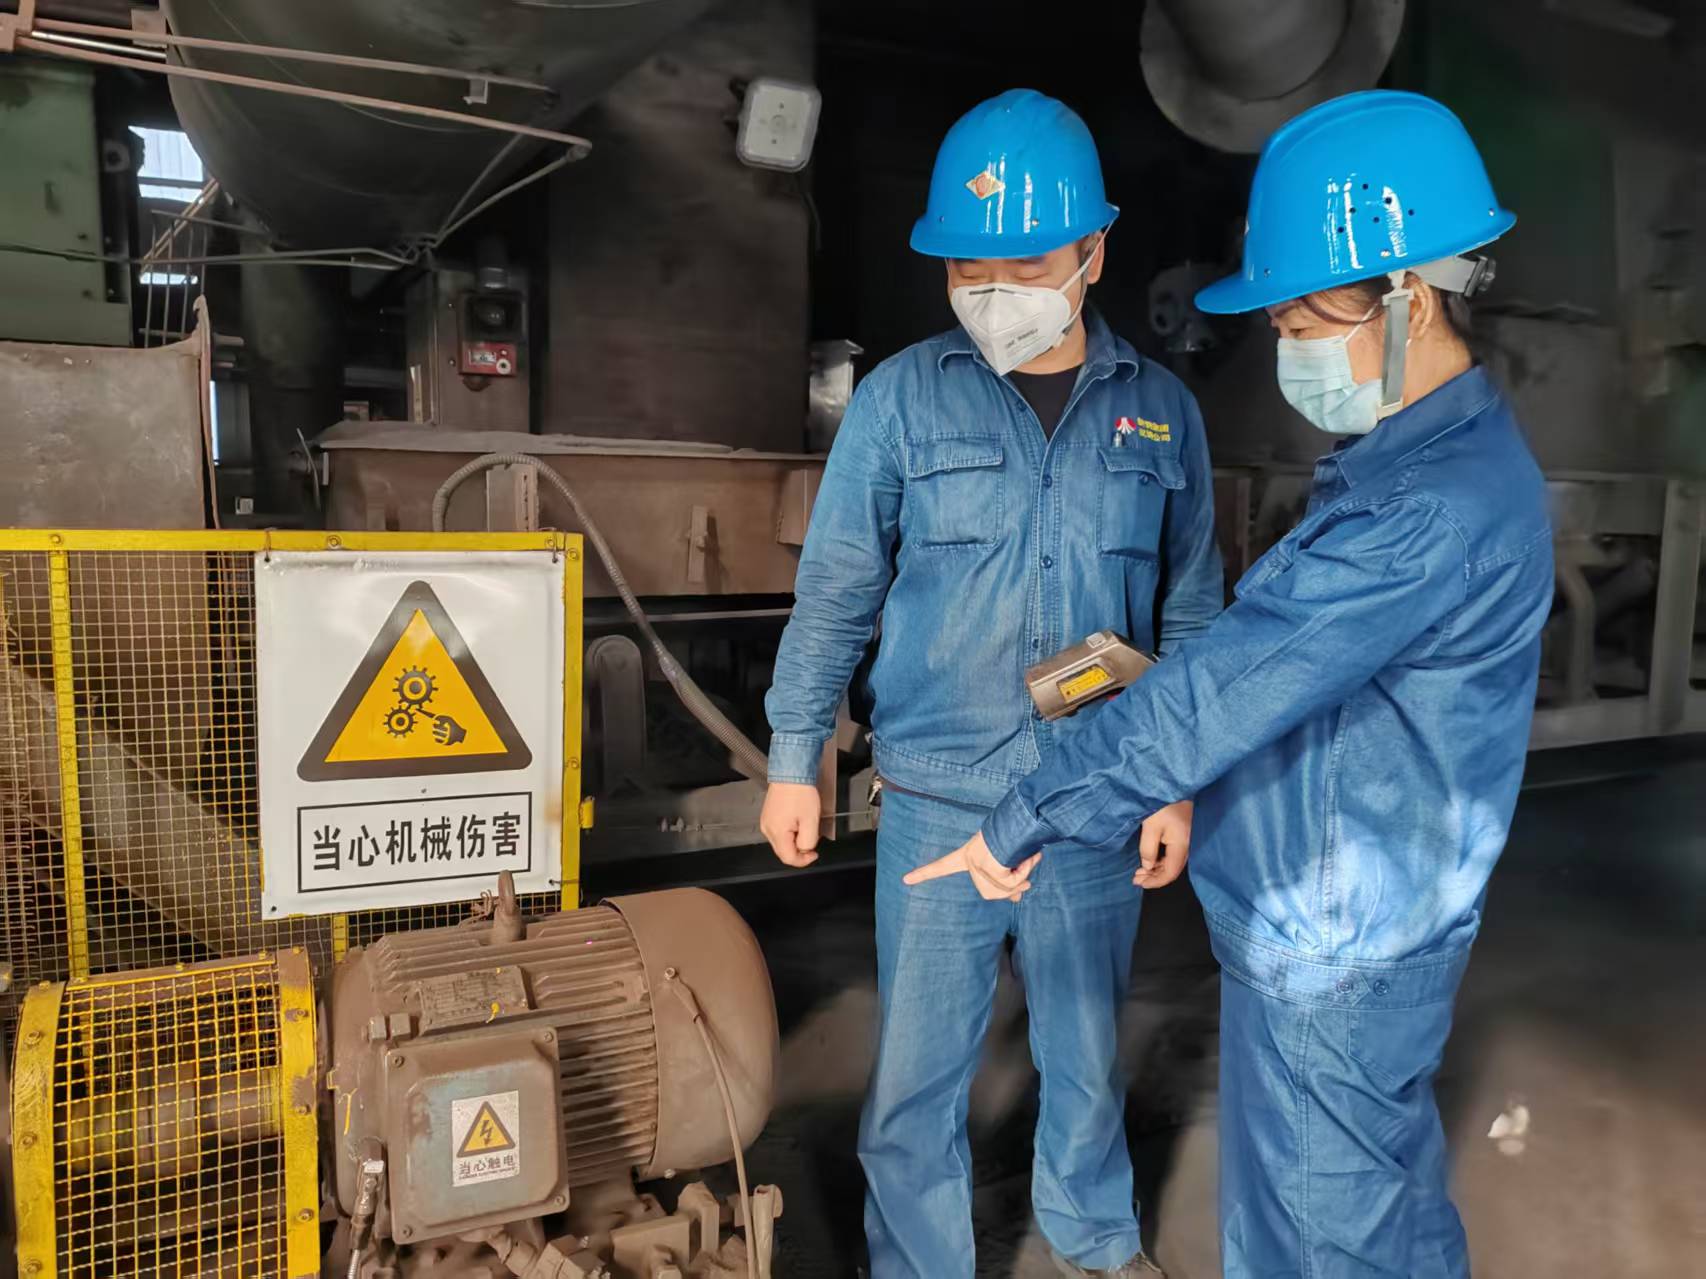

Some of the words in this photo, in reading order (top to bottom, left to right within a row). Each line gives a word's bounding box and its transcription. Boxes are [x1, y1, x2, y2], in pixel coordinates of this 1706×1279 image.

[313, 811, 521, 871] 当心机械伤害
[459, 1154, 516, 1175] 当心触电
